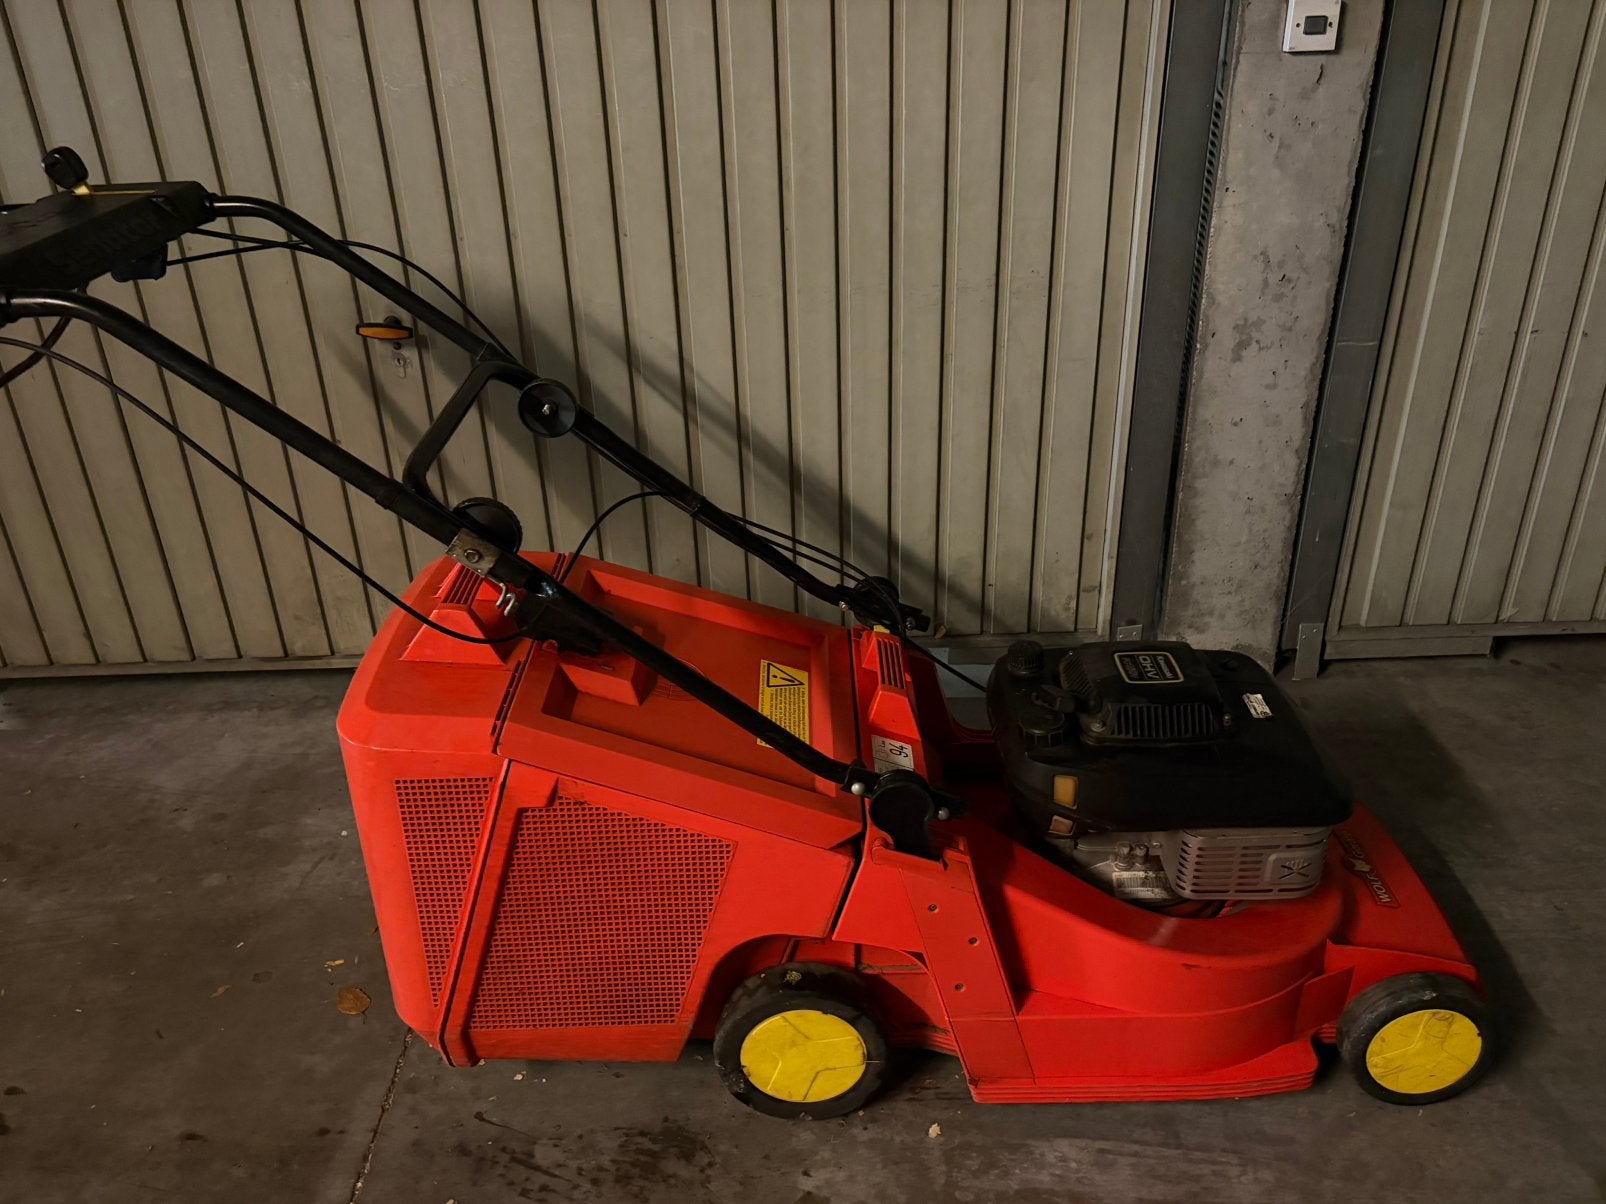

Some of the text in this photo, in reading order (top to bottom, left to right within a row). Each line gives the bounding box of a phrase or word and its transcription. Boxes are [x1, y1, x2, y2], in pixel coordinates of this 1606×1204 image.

[1138, 655, 1160, 679] OHV
[888, 742, 909, 758] 94
[1366, 870, 1392, 903] WOLF
